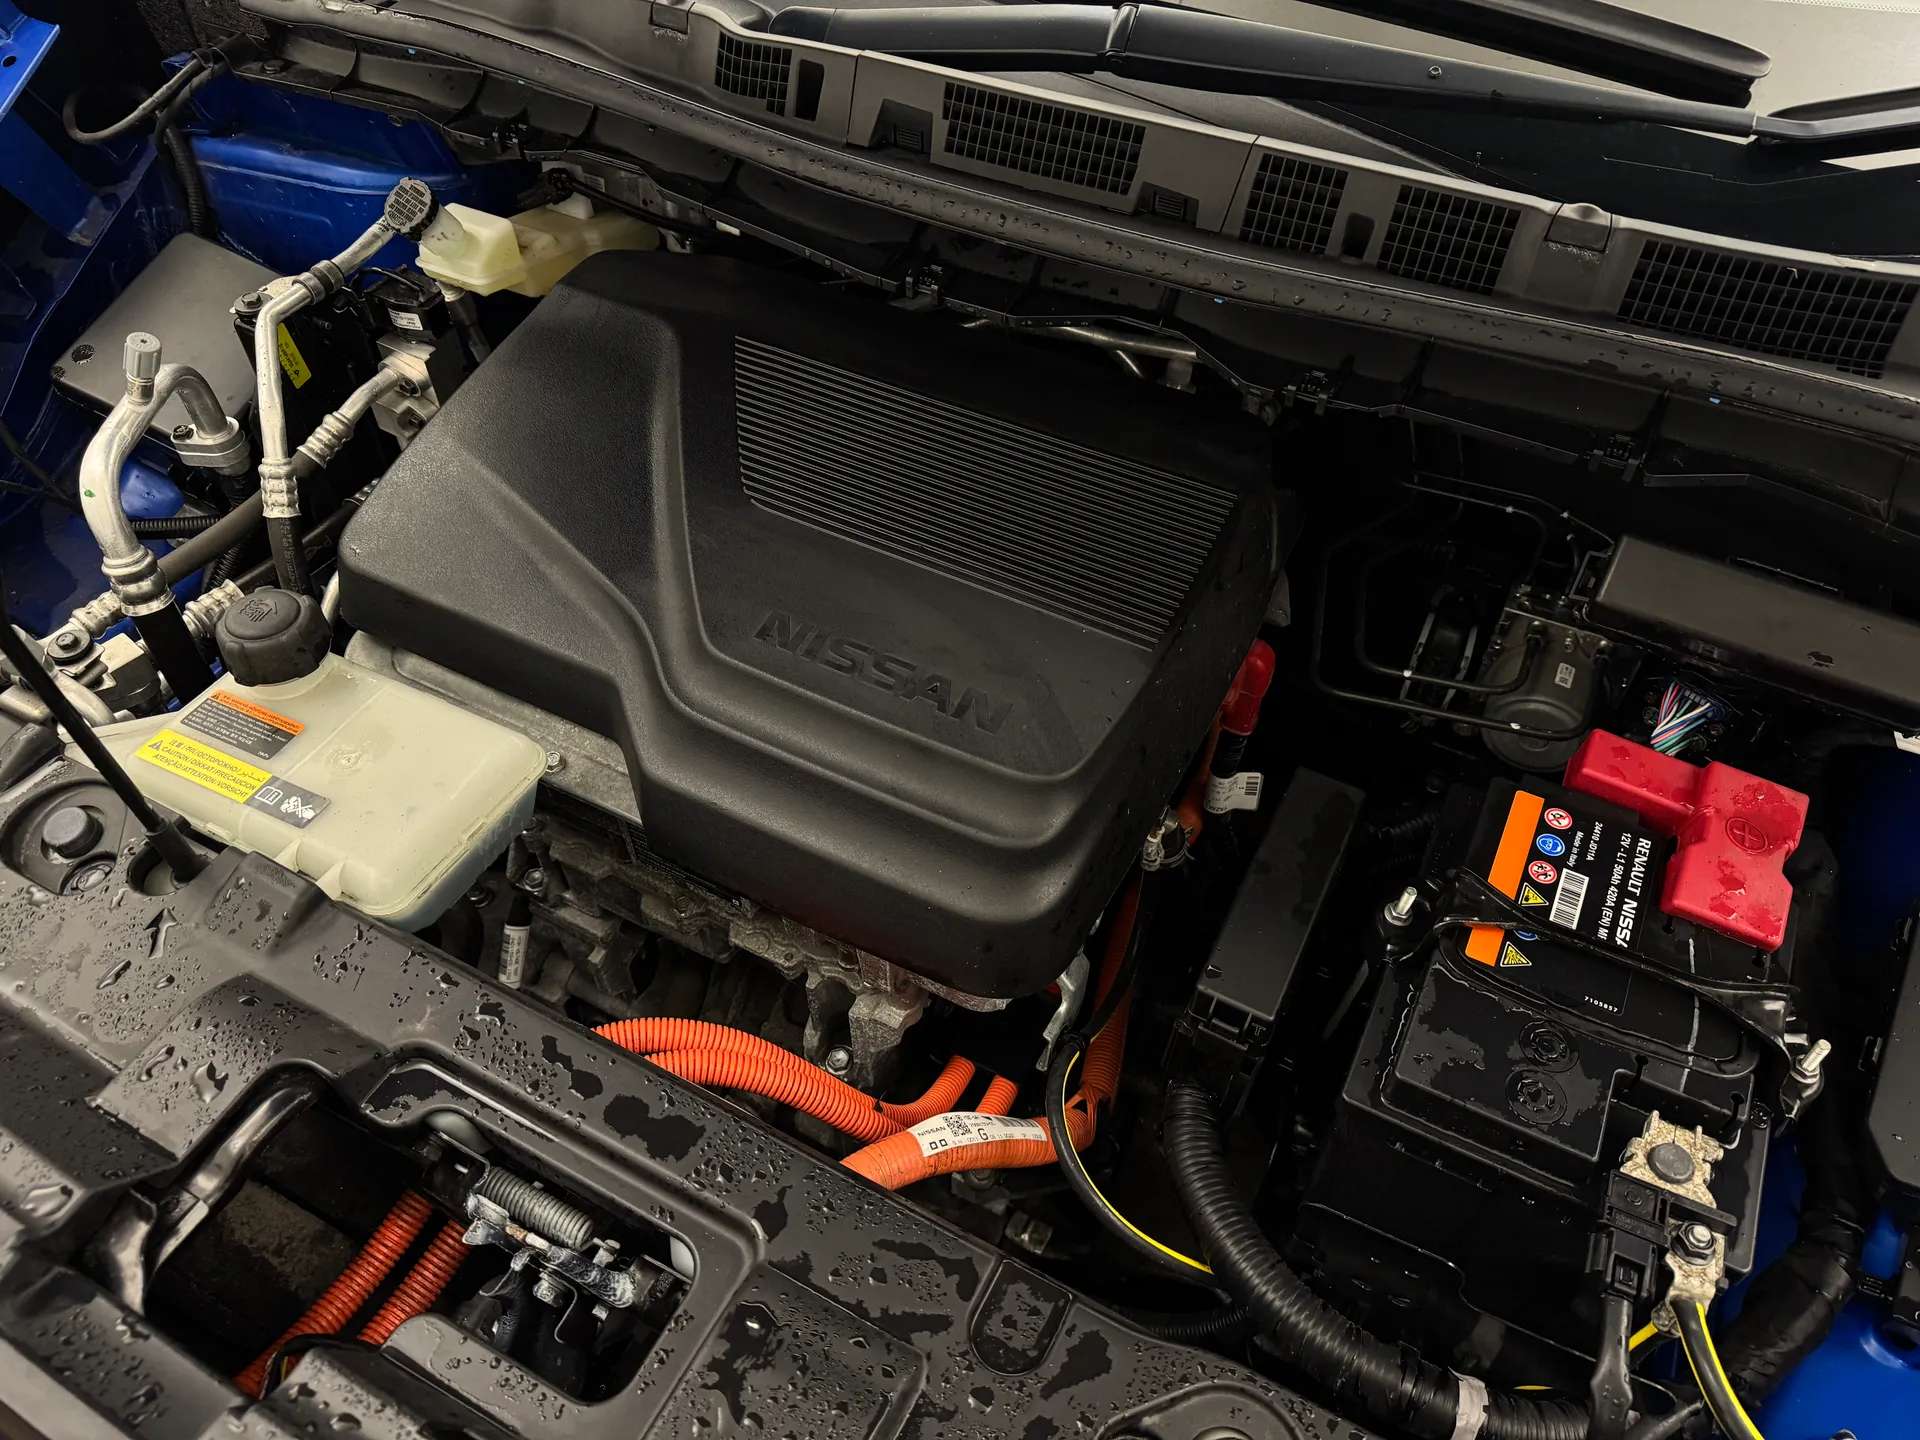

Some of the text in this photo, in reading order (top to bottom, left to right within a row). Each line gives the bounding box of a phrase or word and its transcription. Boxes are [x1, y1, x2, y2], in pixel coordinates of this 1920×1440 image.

[752, 609, 1014, 736] NISSAN
[1573, 831, 1584, 847] Made
[1586, 821, 1603, 861] 24410 JD11A
[1620, 832, 1632, 848] 12V
[1566, 854, 1578, 867] Italy
[1616, 852, 1627, 864] L1
[1627, 837, 1652, 897] RENAULT
[1610, 863, 1624, 885] 50Ah
[1604, 885, 1618, 907] 420A
[1598, 907, 1614, 927] (EN)
[1584, 995, 1618, 1013] 7105857
[917, 1126, 946, 1137] NISSAN
[977, 1127, 989, 1141] G
